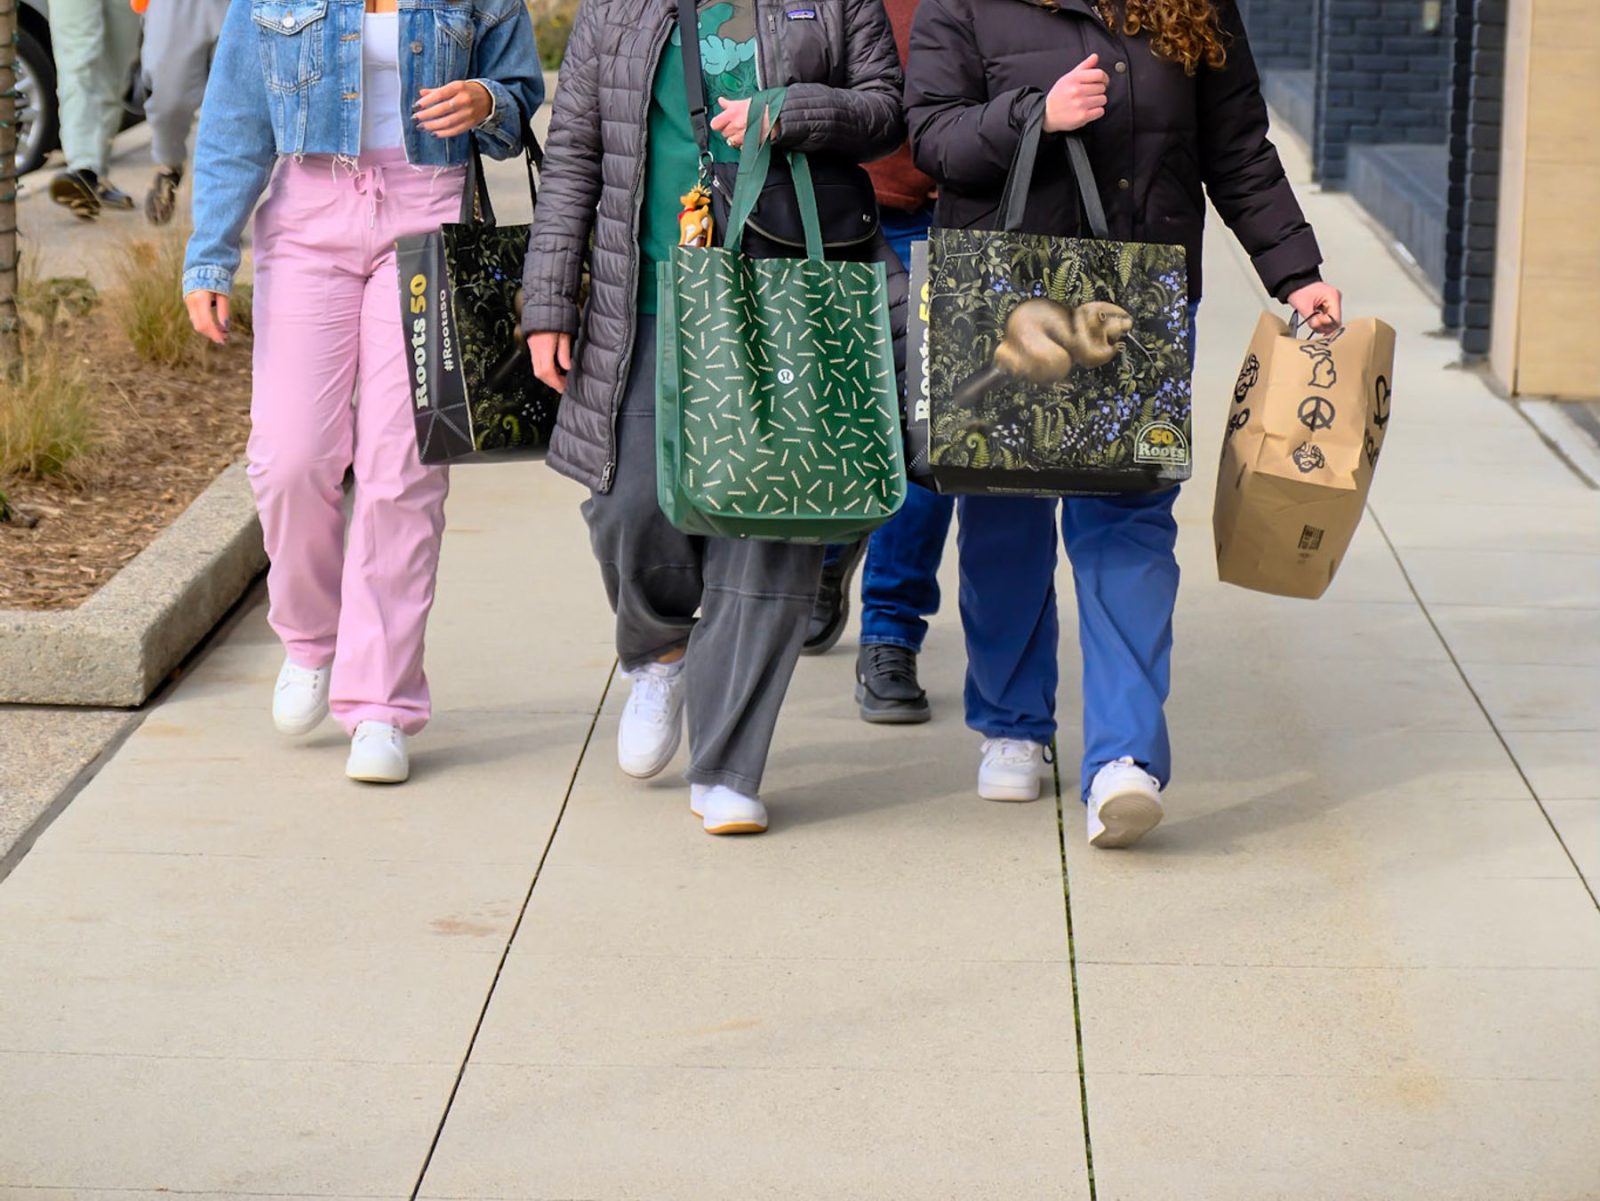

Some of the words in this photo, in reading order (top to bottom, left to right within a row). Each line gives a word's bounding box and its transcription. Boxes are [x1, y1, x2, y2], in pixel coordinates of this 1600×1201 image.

[410, 274, 427, 314] 50
[440, 289, 453, 371] #Roots50
[411, 318, 428, 409] Roots
[1138, 441, 1185, 458] Roots
[1151, 429, 1174, 445] 50
